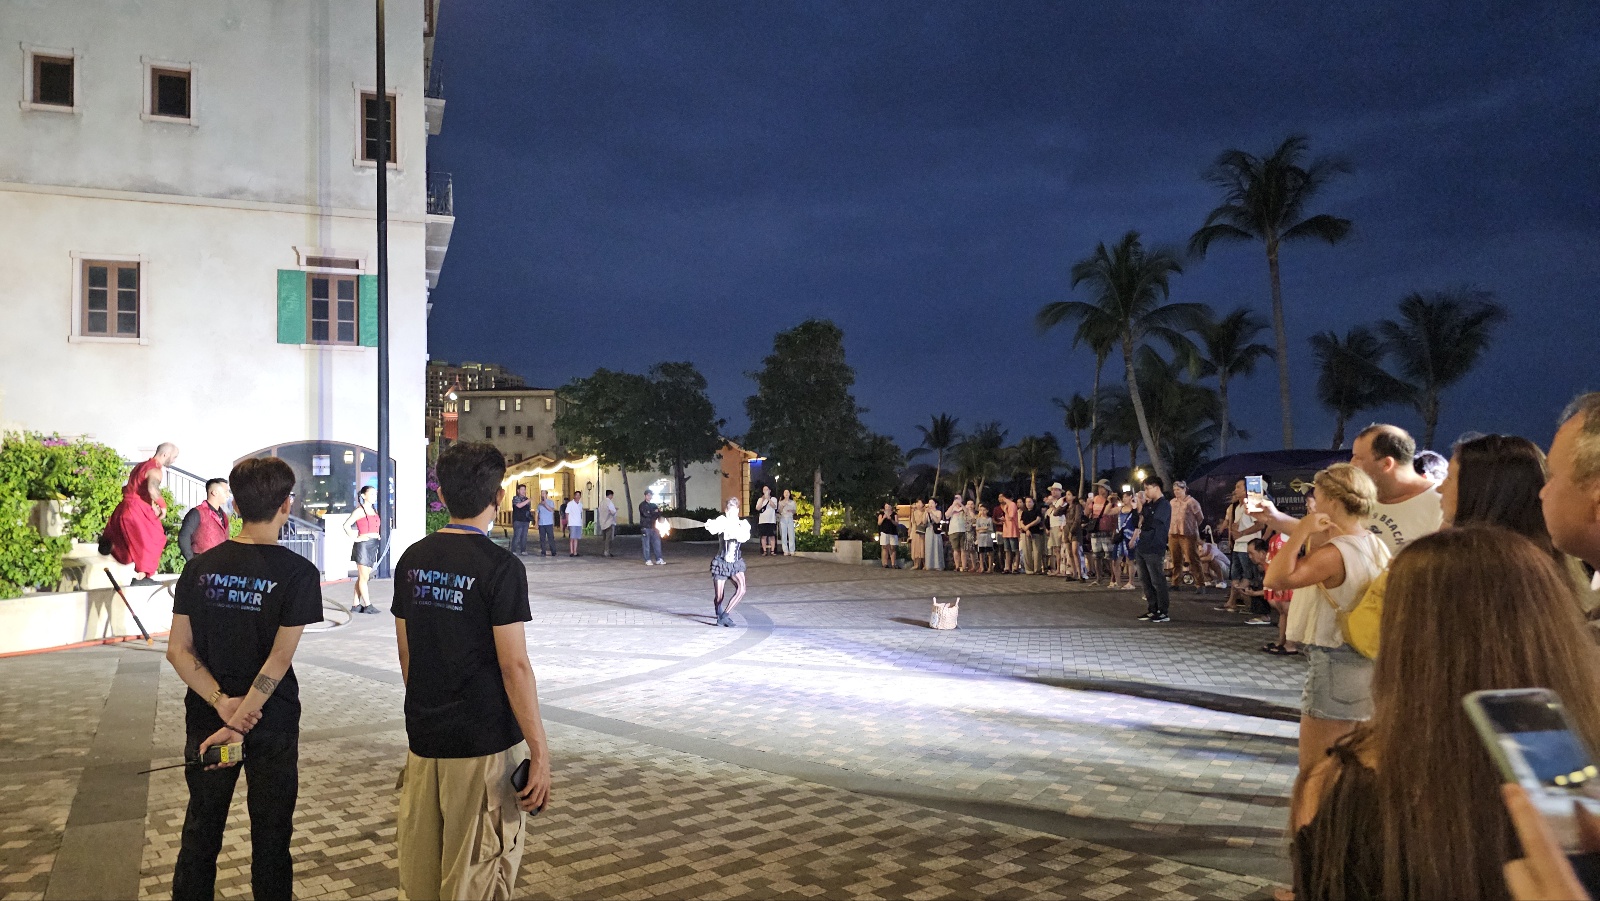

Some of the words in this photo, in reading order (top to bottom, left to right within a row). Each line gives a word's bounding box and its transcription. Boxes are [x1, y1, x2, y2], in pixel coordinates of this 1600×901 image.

[1379, 514, 1406, 545] BEACH
[205, 587, 225, 601] OF
[228, 589, 263, 606] RIVER
[412, 584, 431, 599] OF
[432, 586, 464, 605] RIVER
